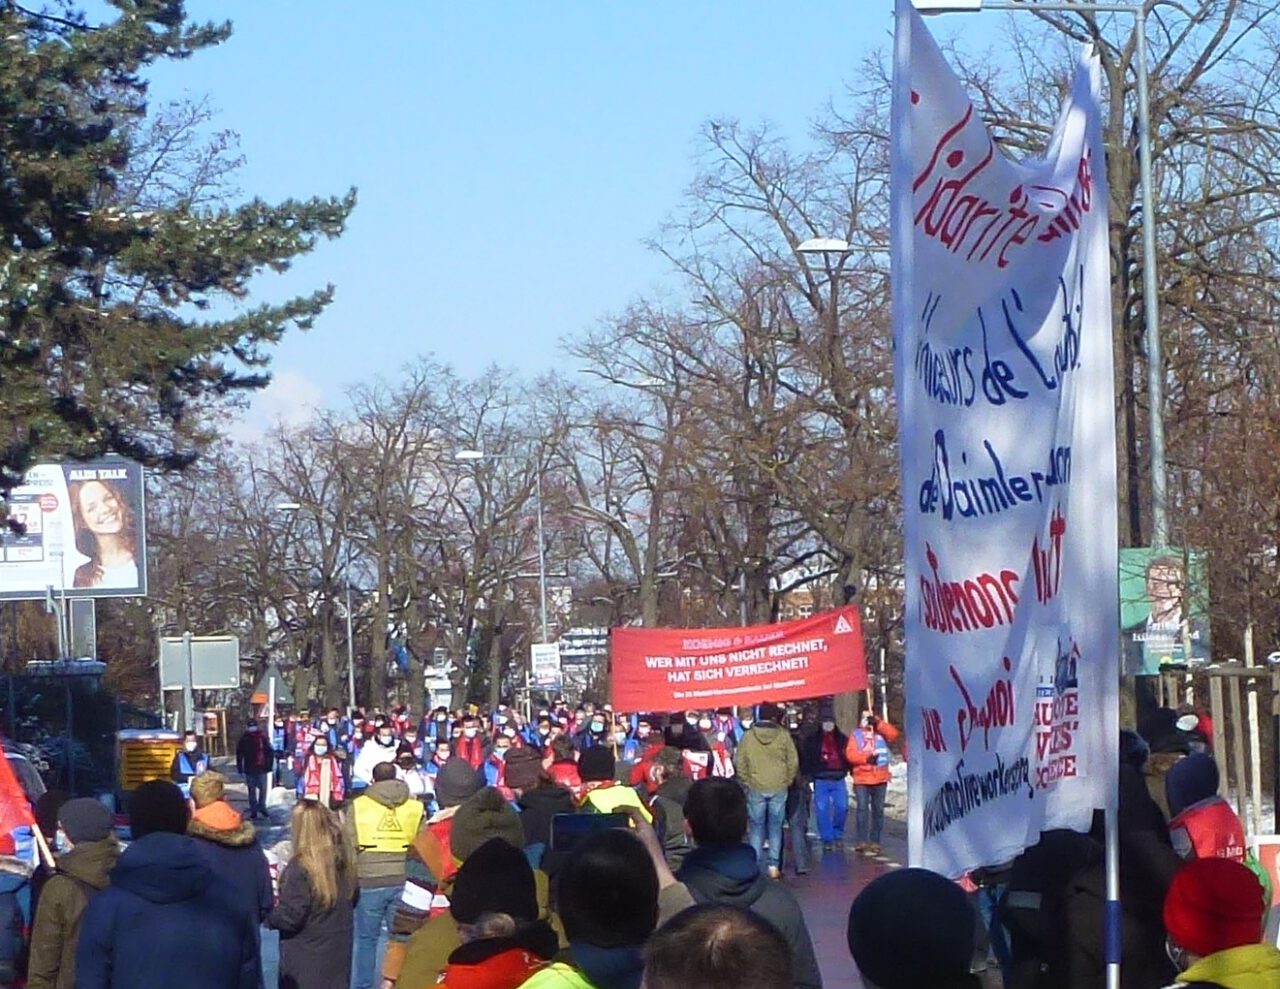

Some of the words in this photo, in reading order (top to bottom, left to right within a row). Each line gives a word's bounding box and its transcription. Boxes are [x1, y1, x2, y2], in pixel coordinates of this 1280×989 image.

[934, 429, 1043, 521] Daimler
[645, 656, 673, 668] WER
[675, 655, 697, 667] MIT
[699, 653, 727, 666] UNS
[729, 648, 768, 664] NICHT
[769, 638, 828, 657] RECHNET,
[667, 669, 691, 683] HAT
[694, 665, 723, 681] SICH
[725, 657, 809, 679] VERRECHNET!
